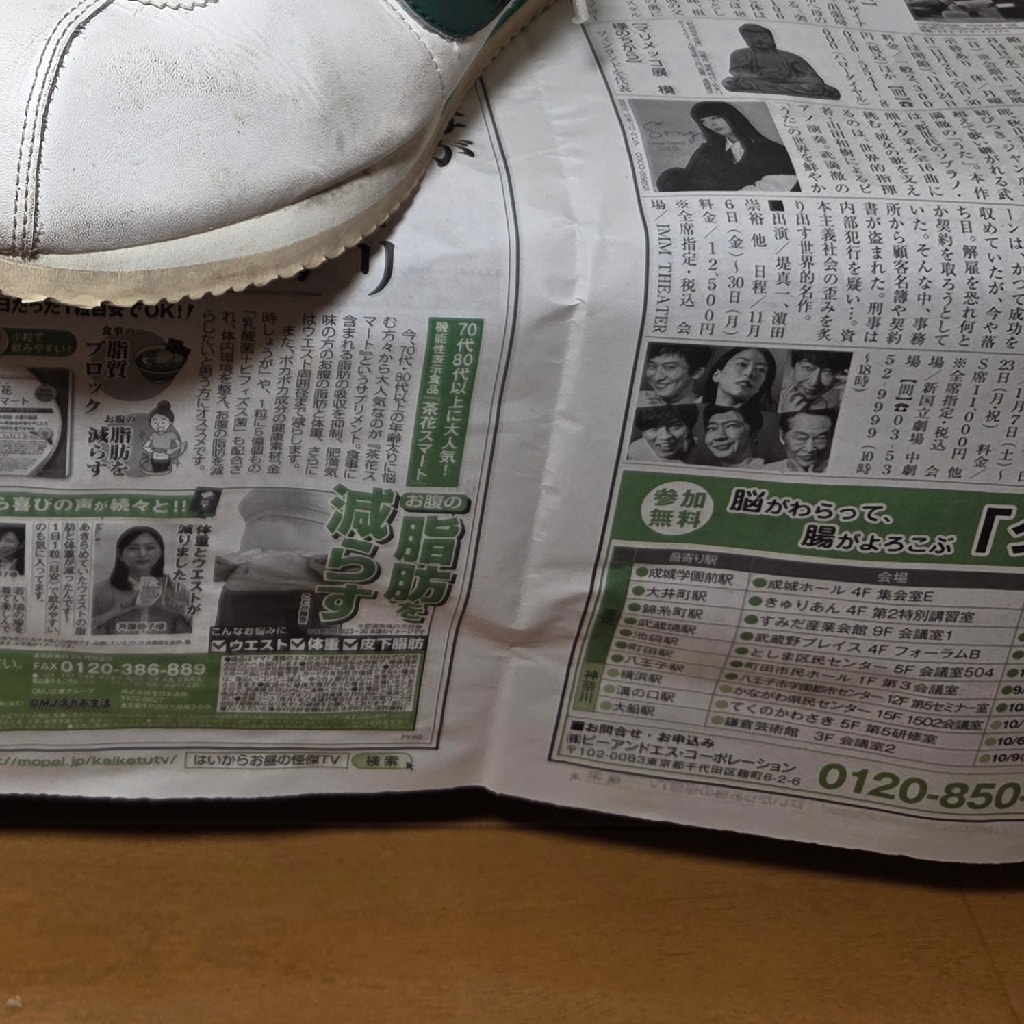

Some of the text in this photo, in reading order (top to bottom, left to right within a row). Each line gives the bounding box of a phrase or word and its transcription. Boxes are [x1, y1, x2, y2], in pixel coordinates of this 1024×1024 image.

[751, 232, 768, 248] 他
[793, 199, 816, 321] り出す世界的名作。
[863, 201, 886, 344] 書が盗まれた。刑事は
[885, 202, 910, 345] 所から顧客名簿や契約
[933, 203, 957, 346] か契約を取ろうとして
[652, 263, 672, 334] THEATER
[85, 339, 106, 415] ブロック
[107, 339, 128, 380] 脂質
[87, 427, 107, 477] 減らす
[108, 427, 132, 476] 脂肪を
[404, 495, 462, 509] お腹の
[652, 487, 707, 510] 参加
[648, 509, 702, 529] 無料
[800, 523, 958, 555] 腸がよろこぶ
[187, 523, 213, 616] 体重とウエストが
[316, 483, 400, 626] 減らす
[384, 516, 465, 624] 脂肪を
[647, 567, 845, 596] 成城学園前駅 成城ホール
[877, 571, 909, 584] 会場
[645, 587, 842, 615] 大井町駅 きゅりあん
[642, 603, 953, 642] 錦糸町駅 すみだ産業会館 会議室1
[228, 636, 424, 651] ウエスト 体重 皮下脂肪
[750, 646, 995, 679] としま区民センター 会議室504
[753, 632, 862, 654] 武蔵野プレイス
[33, 660, 206, 676] FAX 0120-386-889
[620, 669, 663, 684] 横浜駅
[876, 709, 905, 721] 15F
[729, 701, 836, 724] てくのかわさき
[611, 702, 896, 754] 大船駅 会議室2
